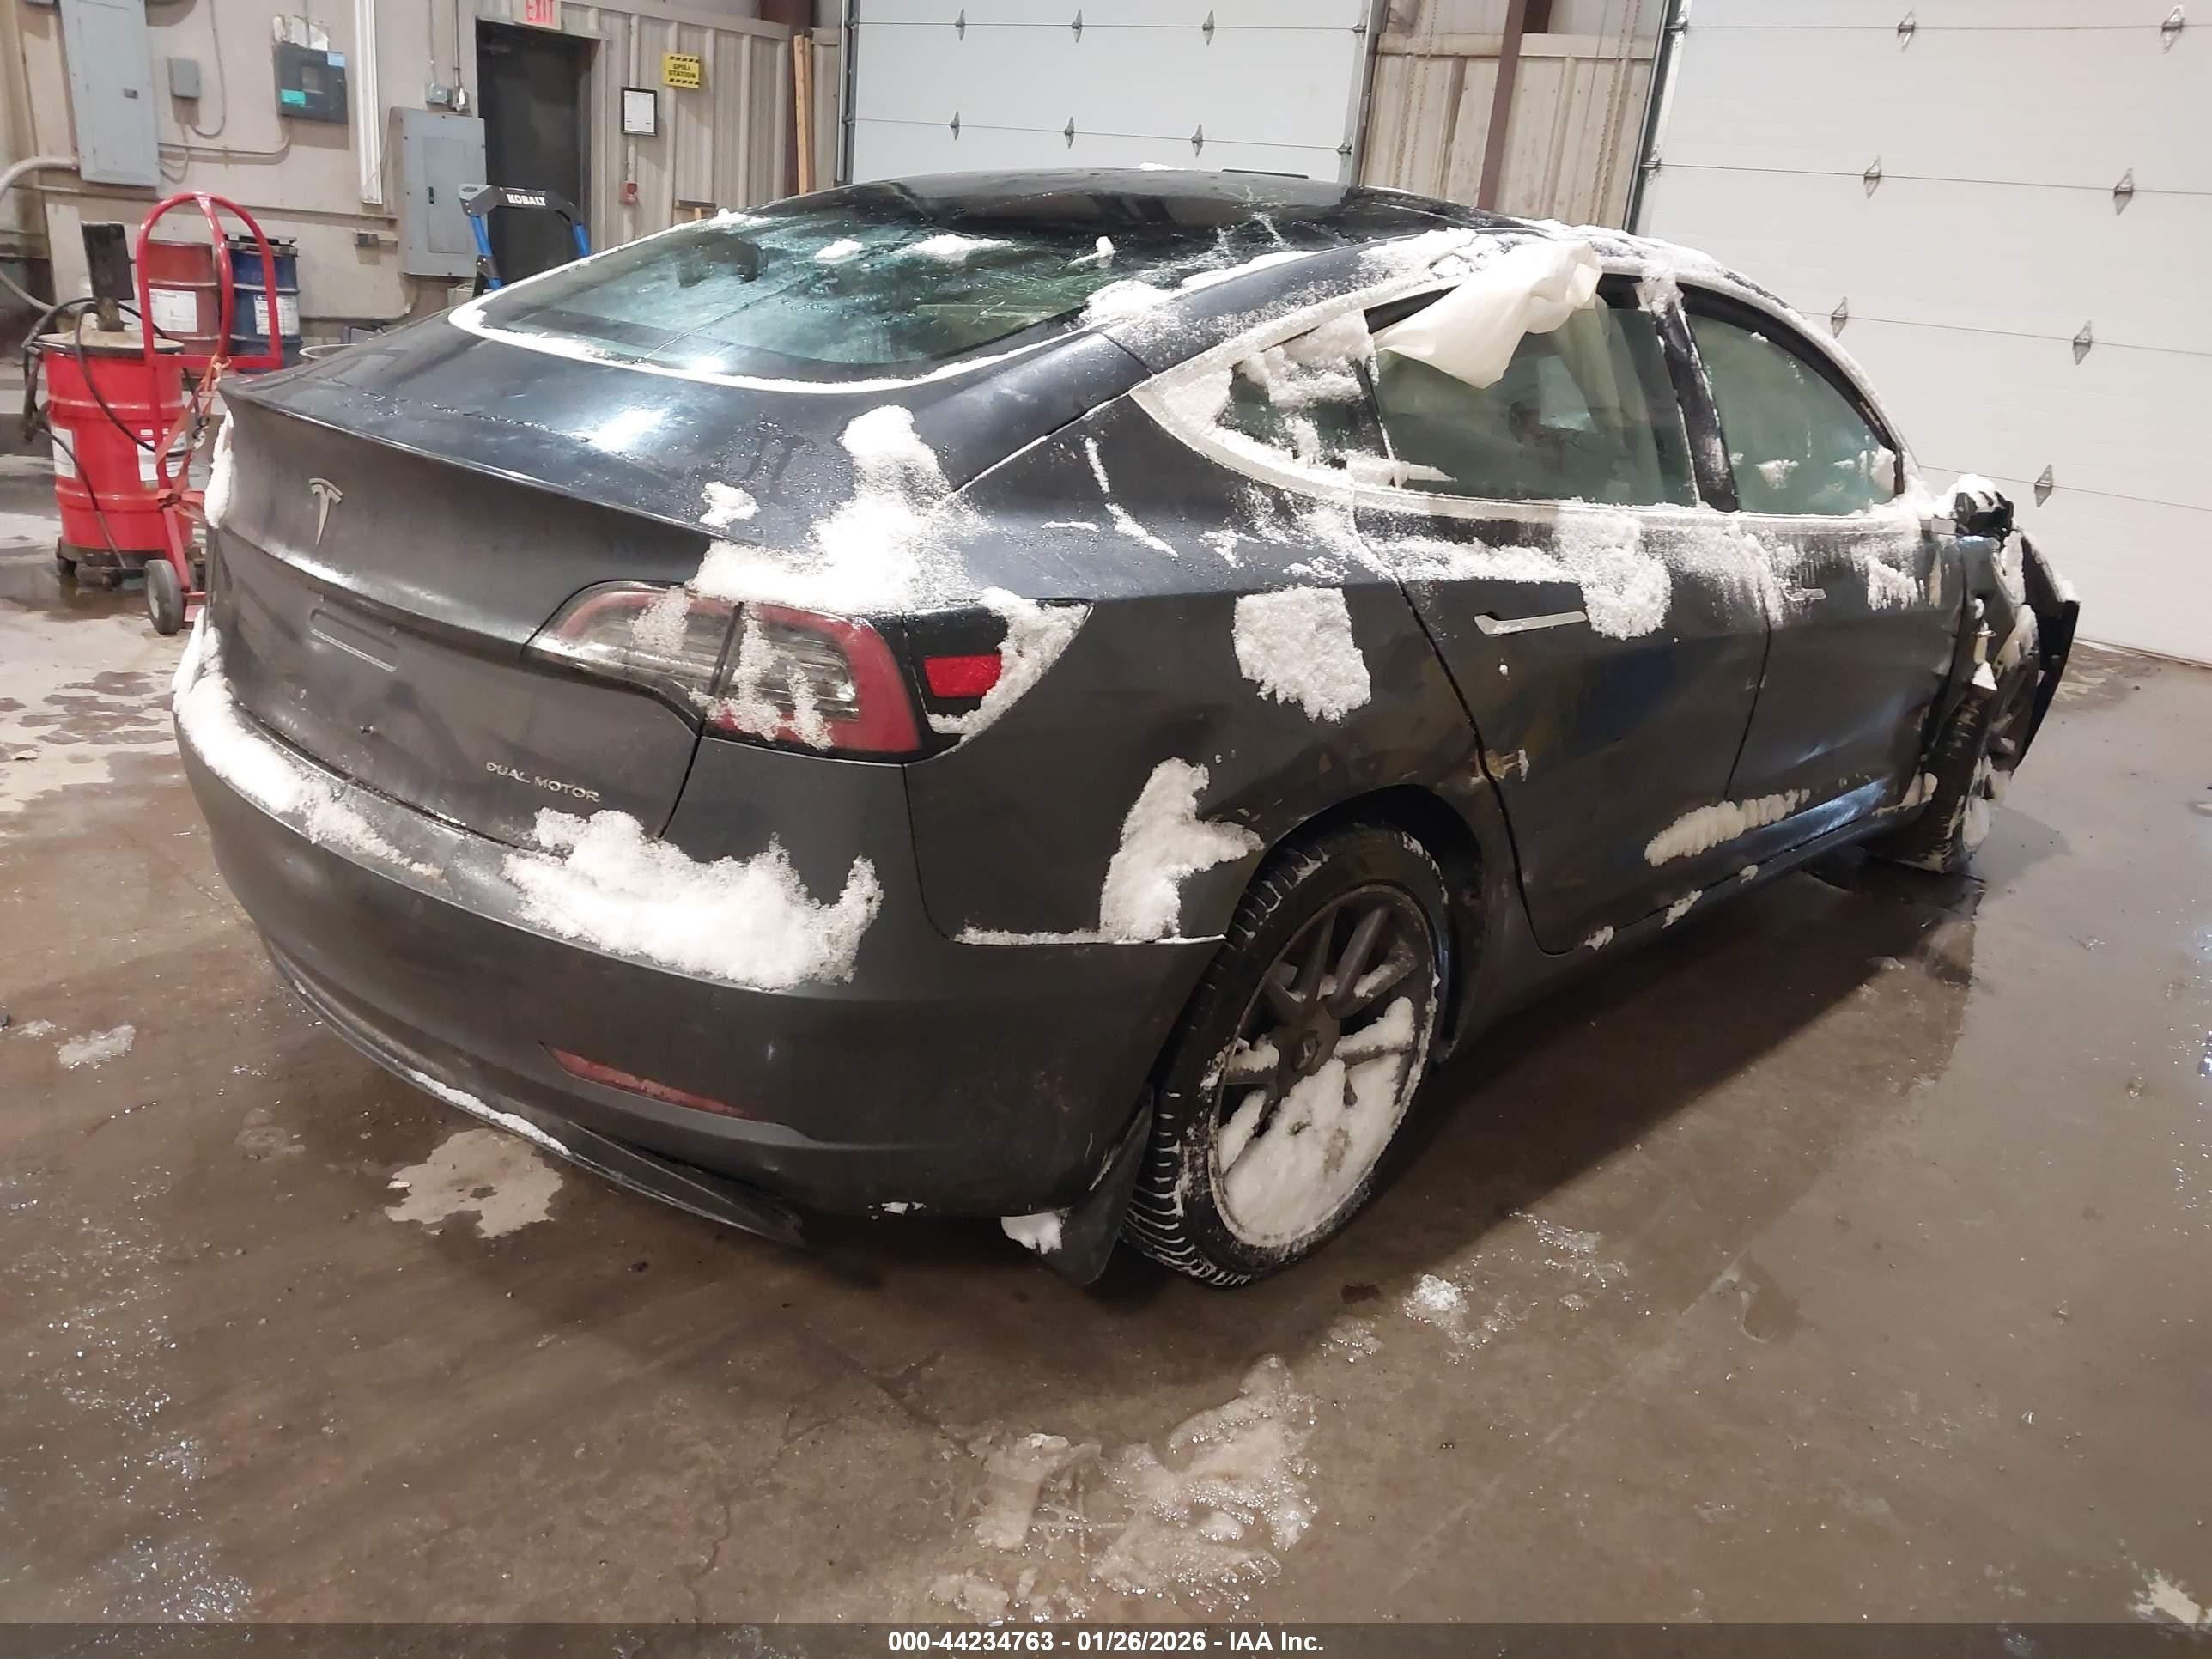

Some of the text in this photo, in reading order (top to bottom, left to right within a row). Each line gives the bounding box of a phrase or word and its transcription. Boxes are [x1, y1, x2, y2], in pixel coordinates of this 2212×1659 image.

[526, 0, 556, 24] EXIT
[668, 70, 696, 78] STATION
[506, 193, 546, 206] KOBALT
[486, 762, 600, 802] DUAL MOTOR
